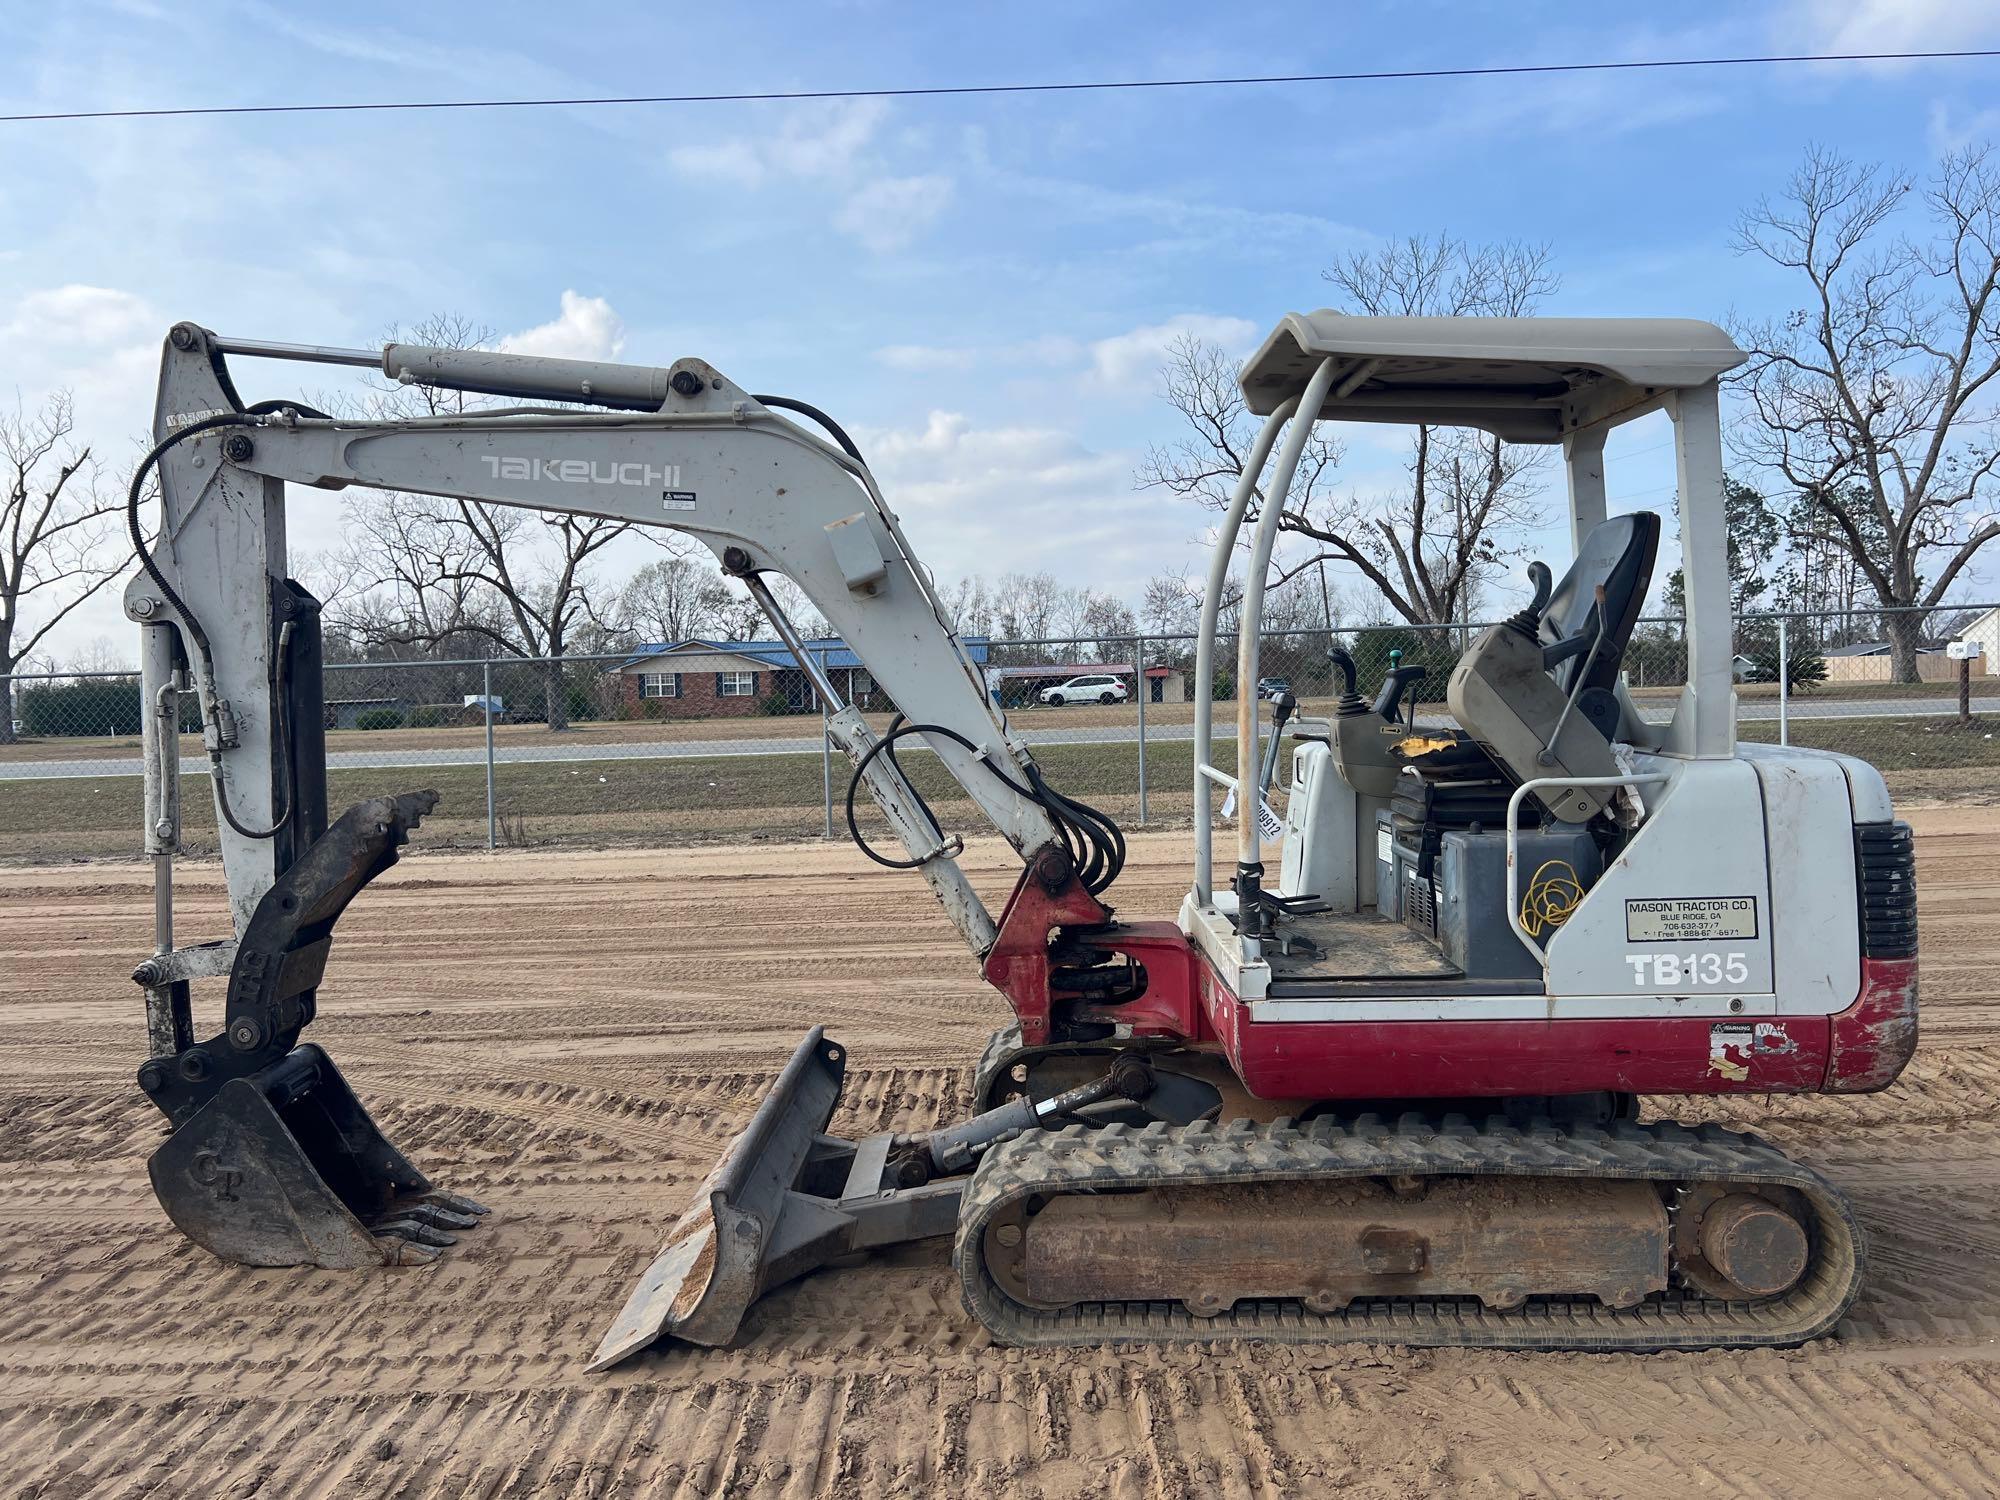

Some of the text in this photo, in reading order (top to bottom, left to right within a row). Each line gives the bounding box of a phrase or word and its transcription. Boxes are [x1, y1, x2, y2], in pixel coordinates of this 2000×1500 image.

[1629, 900, 1751, 913] MASON TRACTOR CO.
[1660, 913, 1680, 921] BLUE
[1710, 912, 1721, 920] GA
[1626, 952, 1748, 986] TB135
